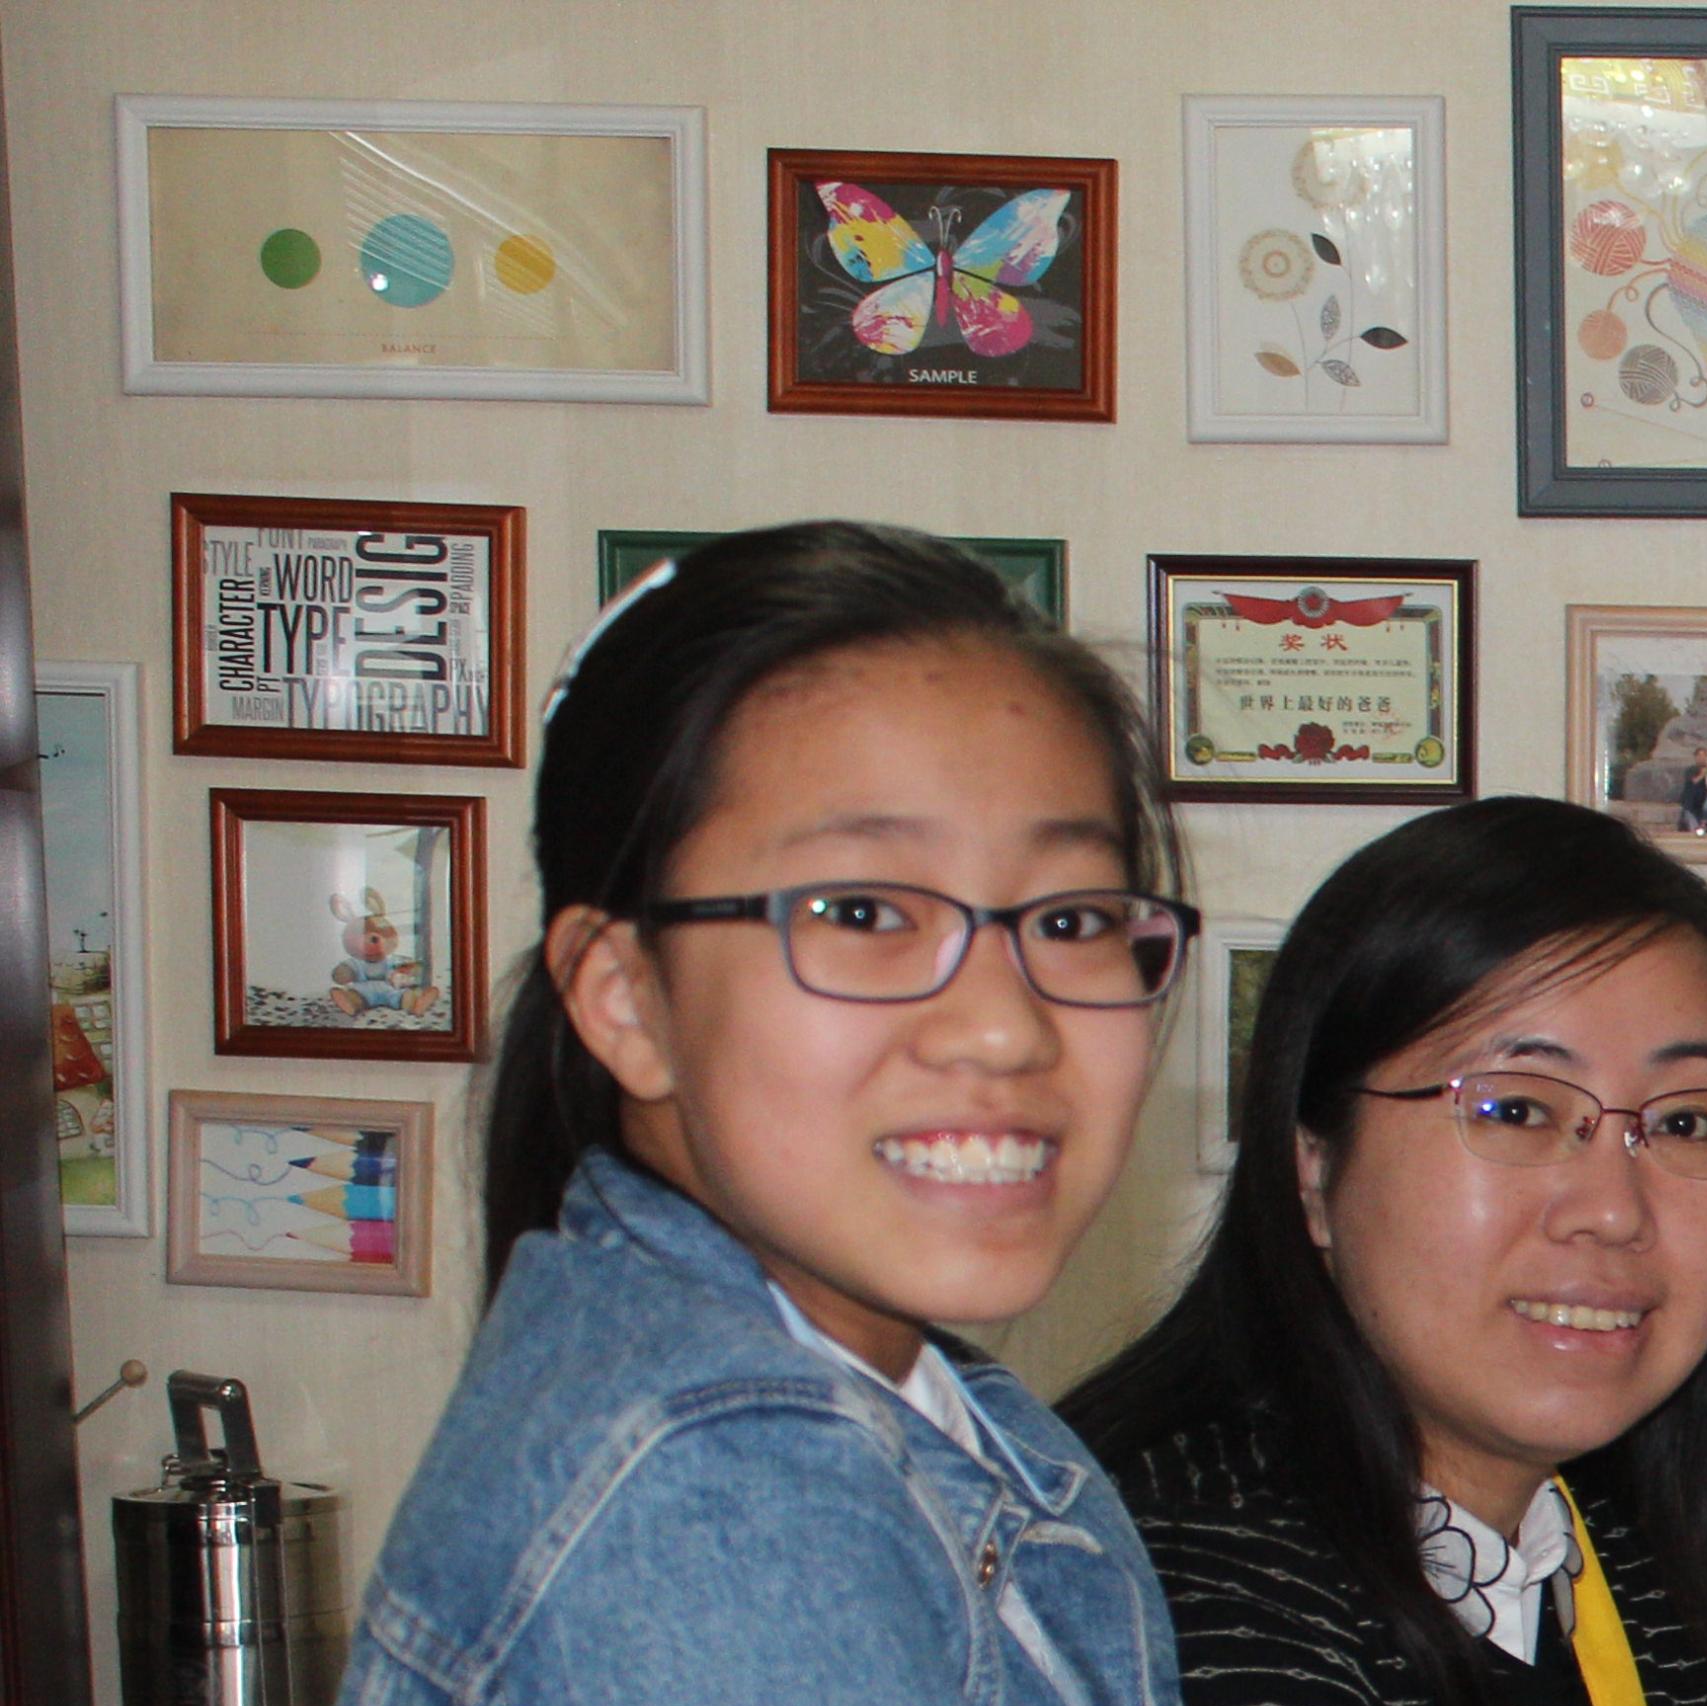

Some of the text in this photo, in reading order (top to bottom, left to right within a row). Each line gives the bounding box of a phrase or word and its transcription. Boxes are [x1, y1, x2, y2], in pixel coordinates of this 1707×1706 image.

[382, 344, 436, 353] BALANCE
[909, 368, 977, 384] SAMPLE
[274, 553, 353, 603] WORD
[451, 543, 474, 600] PADDING
[219, 578, 255, 692] CHARACTER
[257, 602, 350, 675] TYPE
[257, 676, 280, 692] PT
[231, 695, 285, 722] MARGIN
[1239, 694, 1393, 714] 世界上最好的爸爸
